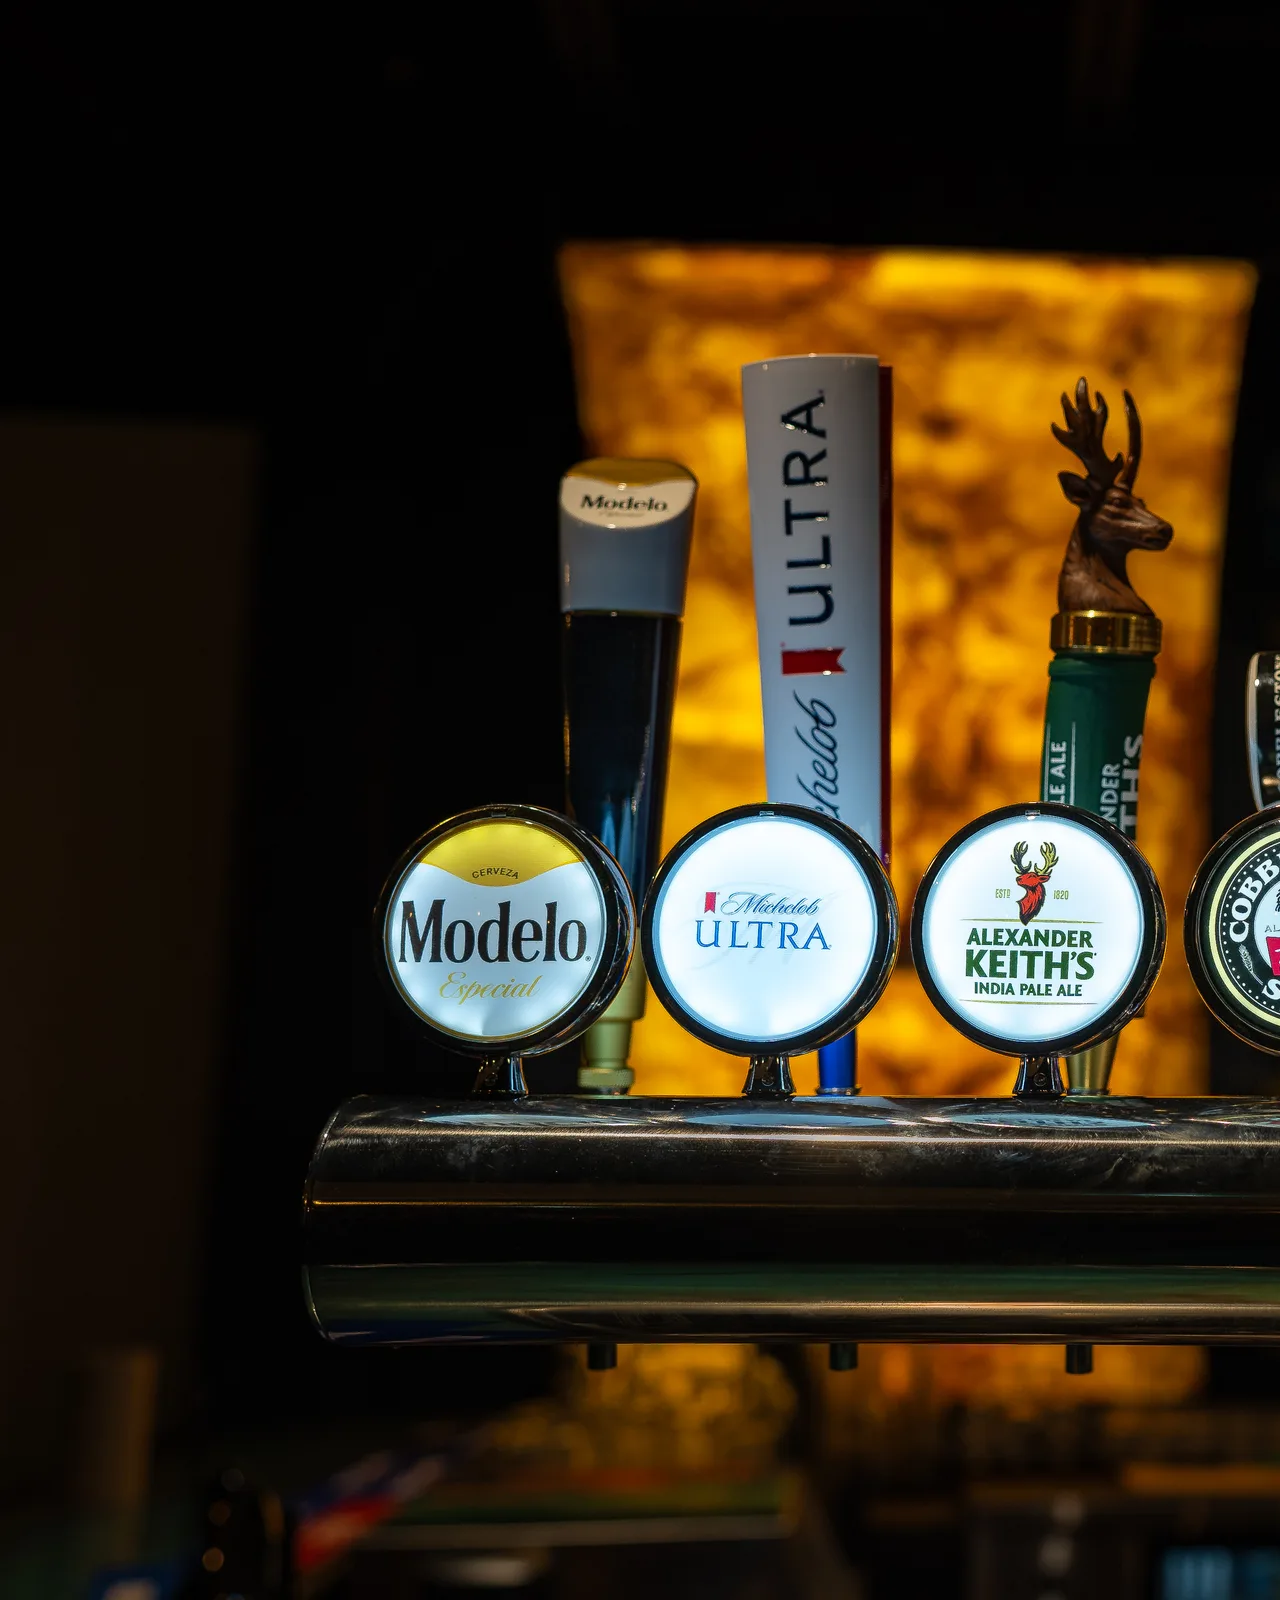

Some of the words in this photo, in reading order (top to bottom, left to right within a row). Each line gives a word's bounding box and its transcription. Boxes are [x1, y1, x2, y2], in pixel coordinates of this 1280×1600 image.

[581, 494, 668, 513] Modelo
[781, 395, 834, 626] ULTRA
[1050, 740, 1067, 779] ALE
[472, 867, 520, 879] CERVEZA
[720, 891, 823, 915] Michelob
[1053, 889, 1069, 900] 1820
[398, 898, 588, 964] Modelo
[695, 919, 831, 950] ULTRA
[966, 927, 1094, 948] ALEXANDER
[965, 949, 1095, 980] KEITH'S
[438, 971, 544, 1005] Especial
[974, 982, 1016, 996] INDIA
[1019, 983, 1053, 997] PALE
[1056, 984, 1083, 997] ALE
